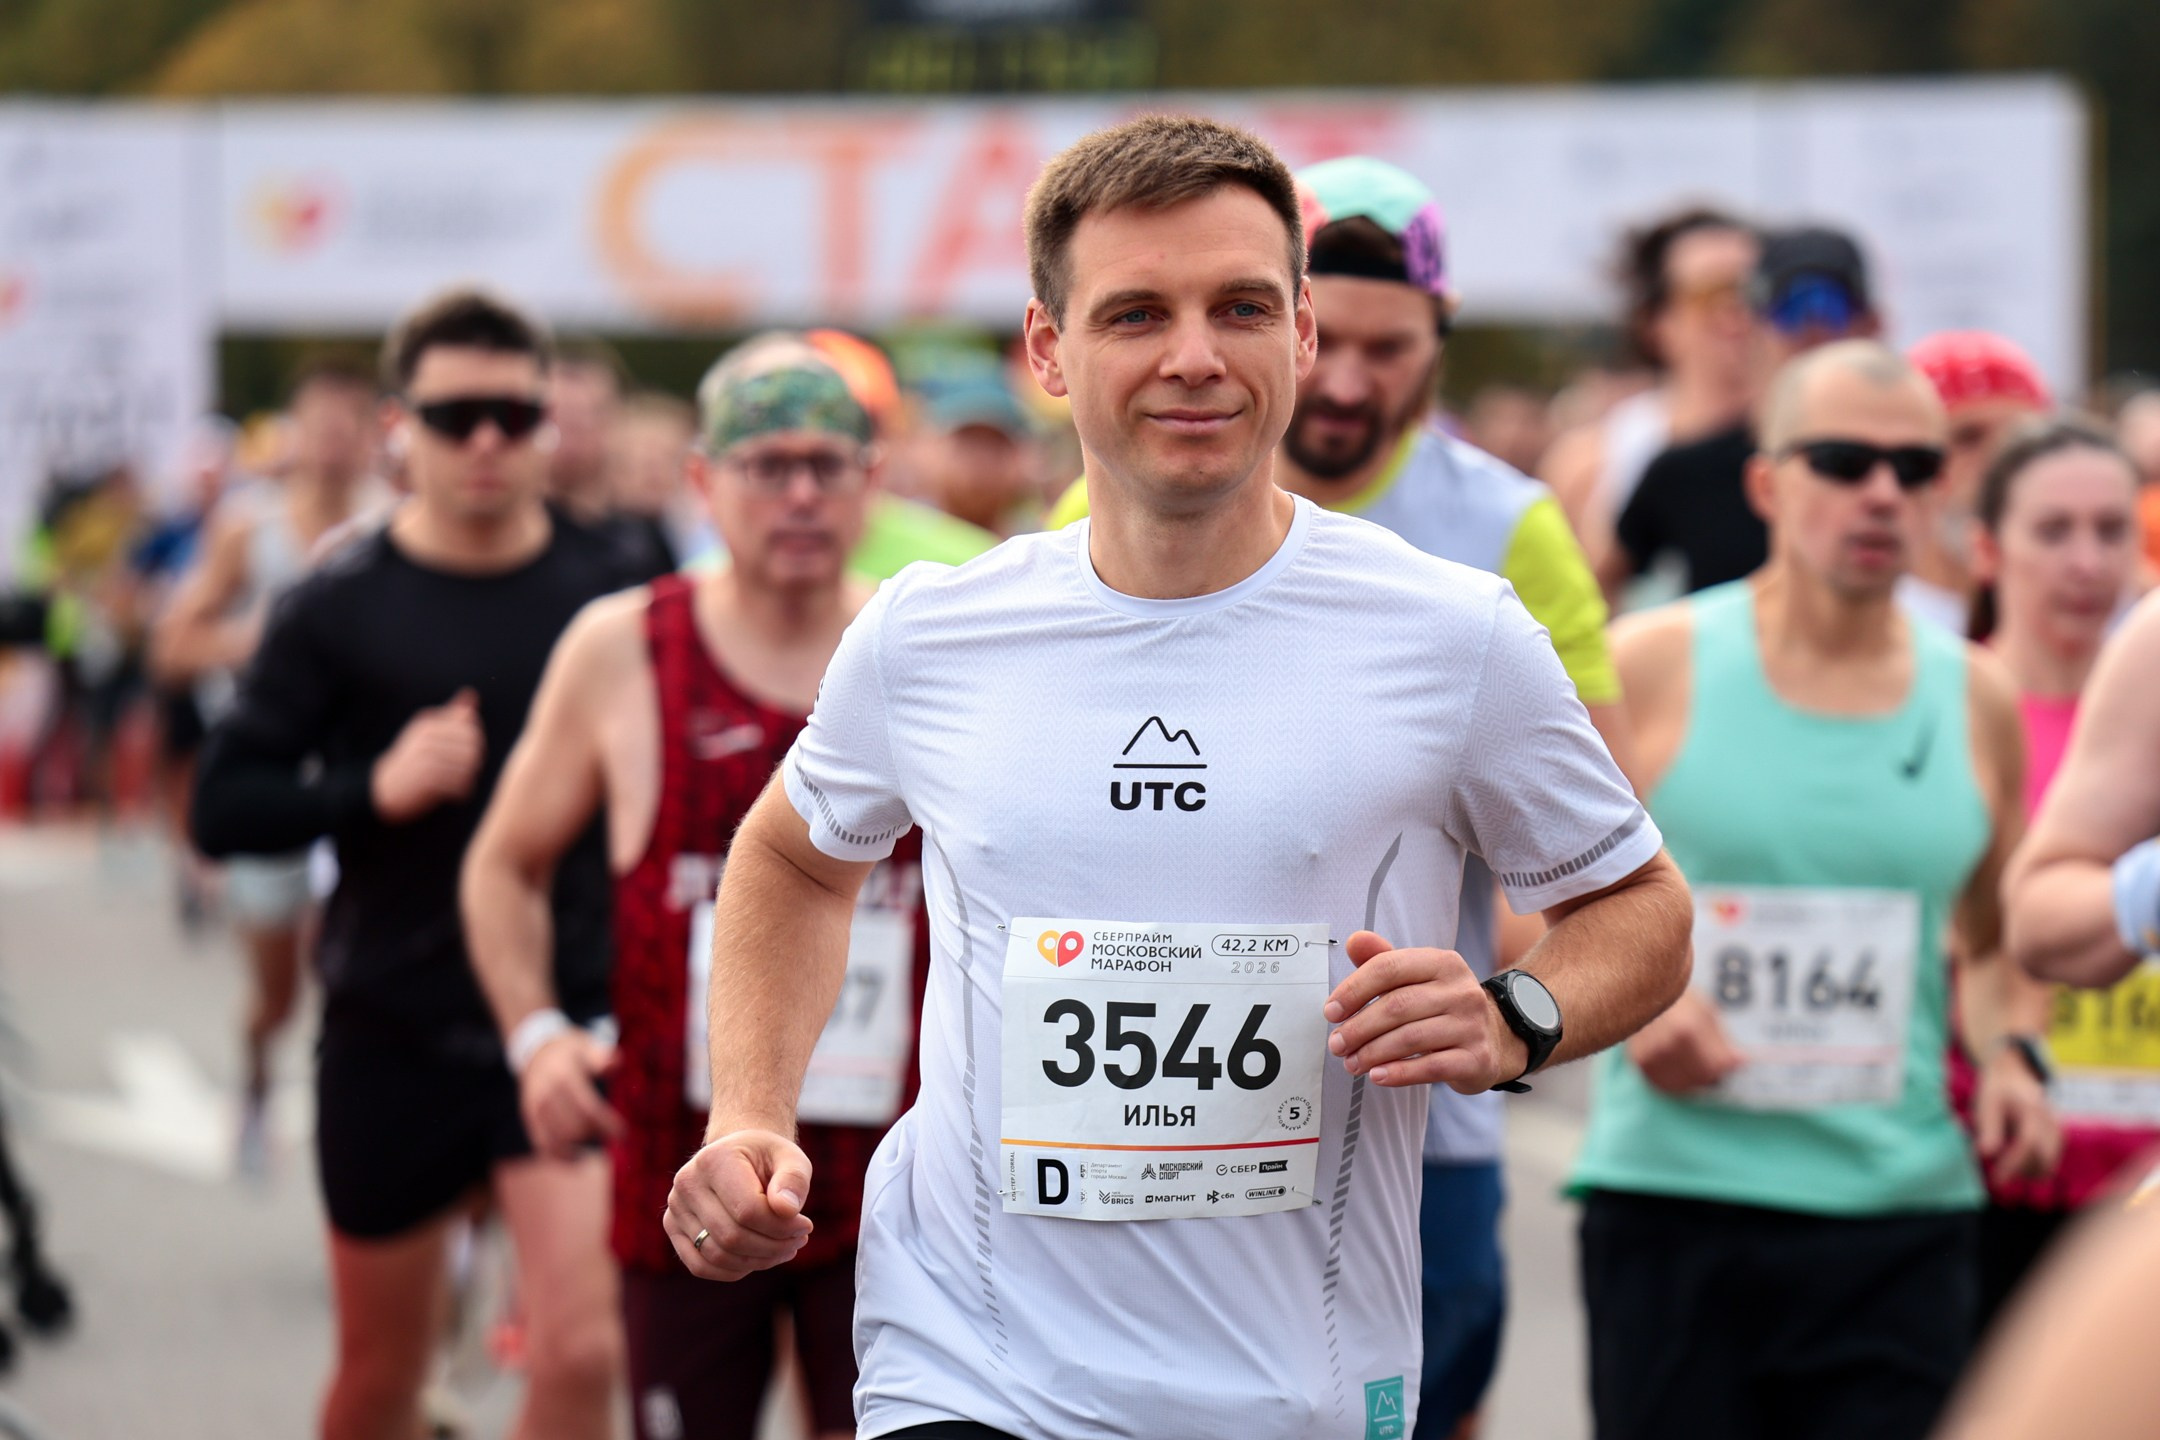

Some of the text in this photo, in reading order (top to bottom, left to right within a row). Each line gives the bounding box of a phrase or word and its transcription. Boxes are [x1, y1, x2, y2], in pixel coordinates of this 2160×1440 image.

[1110, 781, 1206, 812] UTC
[1093, 931, 1173, 944] СБЕРПРАЙМ
[1091, 943, 1202, 959] МОСКОВСКИЙ
[1221, 938, 1289, 954] 42,2 КМ
[1090, 958, 1172, 973] МАРАФОН
[1230, 961, 1280, 974] 2026
[1713, 943, 1878, 1013] 8164
[1042, 998, 1281, 1091] 3546
[1124, 1104, 1196, 1127] ИЛЬЯ
[1289, 1106, 1300, 1120] 5
[1159, 1160, 1203, 1172] МОСКОВСКИЙ
[1230, 1163, 1283, 1173] СБЕР Прайм
[1037, 1158, 1070, 1205] D
[1159, 1171, 1180, 1180] СПОРТ
[1248, 1188, 1278, 1198] WINLINE
[1111, 1197, 1134, 1205] BRICS
[1379, 1424, 1394, 1436] UTC
